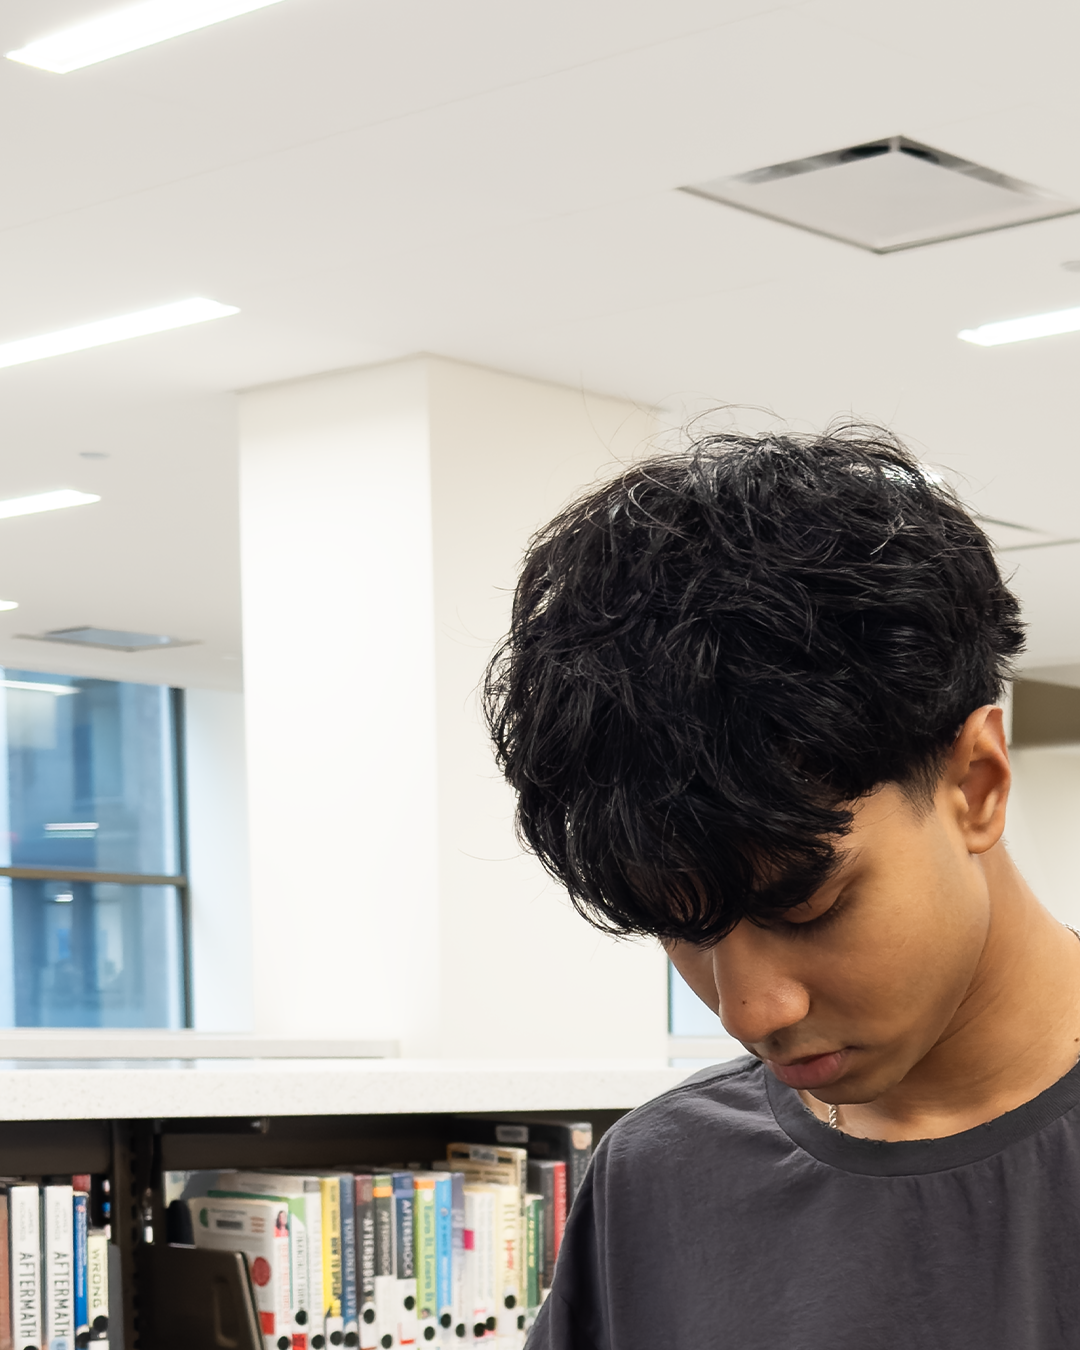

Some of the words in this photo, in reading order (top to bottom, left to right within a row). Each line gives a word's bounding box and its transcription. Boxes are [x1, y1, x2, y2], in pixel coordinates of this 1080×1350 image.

[344, 1218, 354, 1244] YOU
[362, 1218, 374, 1293] AFTERSHOCK
[402, 1200, 414, 1277] AFTERSHOCK
[19, 1252, 36, 1338] AFTERMATH
[54, 1251, 70, 1338] AFTERMATH
[91, 1248, 102, 1309] WRONG
[345, 1250, 354, 1282] ONLY
[424, 1254, 434, 1288] Learn
[346, 1286, 356, 1317] LIVE
